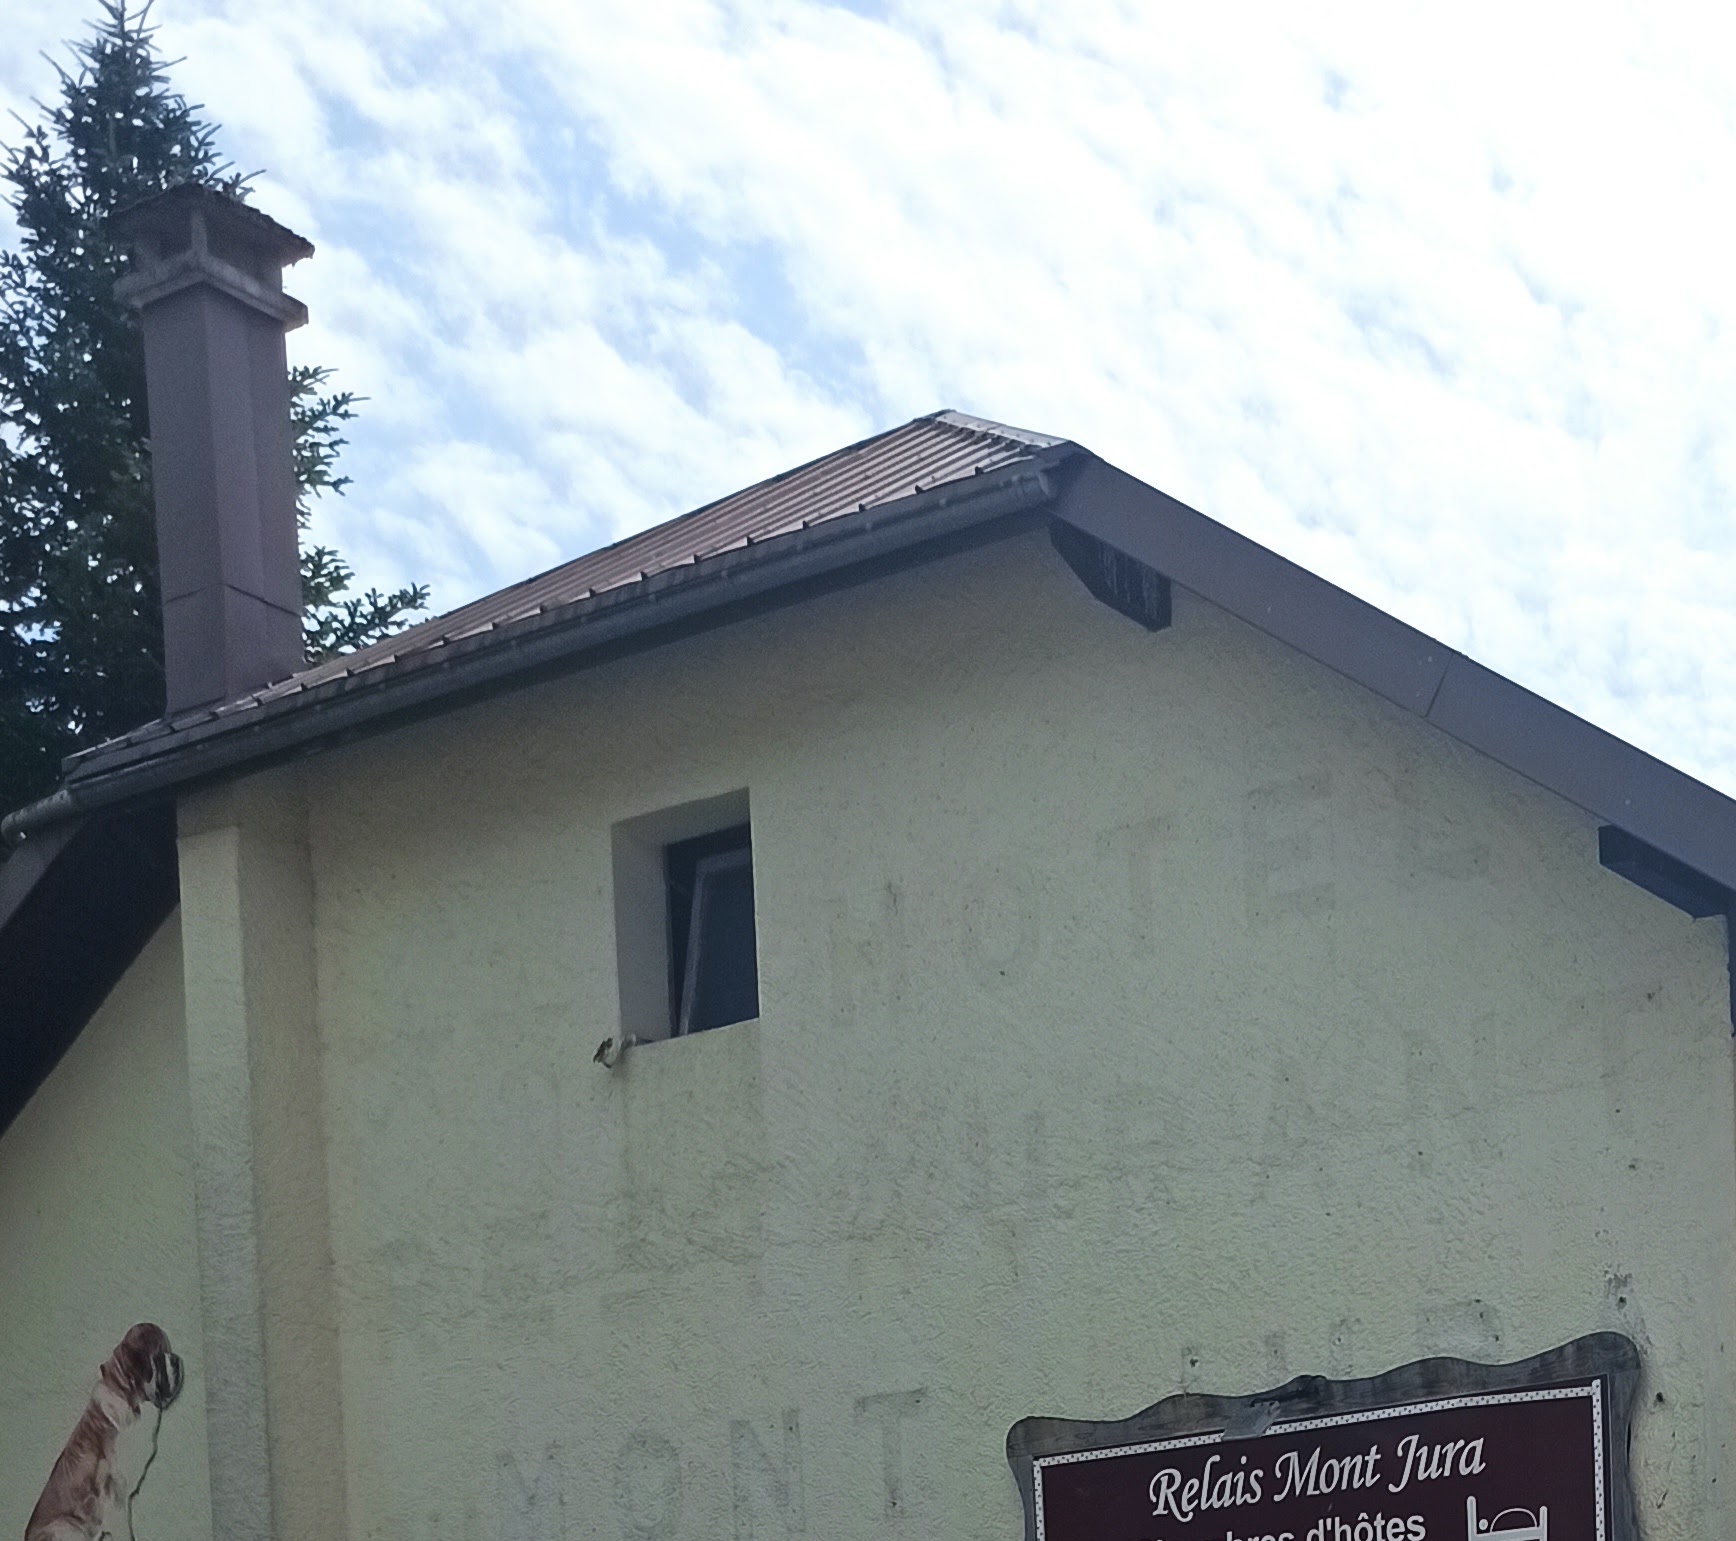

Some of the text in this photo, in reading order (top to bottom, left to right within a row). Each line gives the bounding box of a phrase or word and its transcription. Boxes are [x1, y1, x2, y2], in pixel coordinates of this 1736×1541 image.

[1149, 1434, 1486, 1523] Relais Mont Jura
